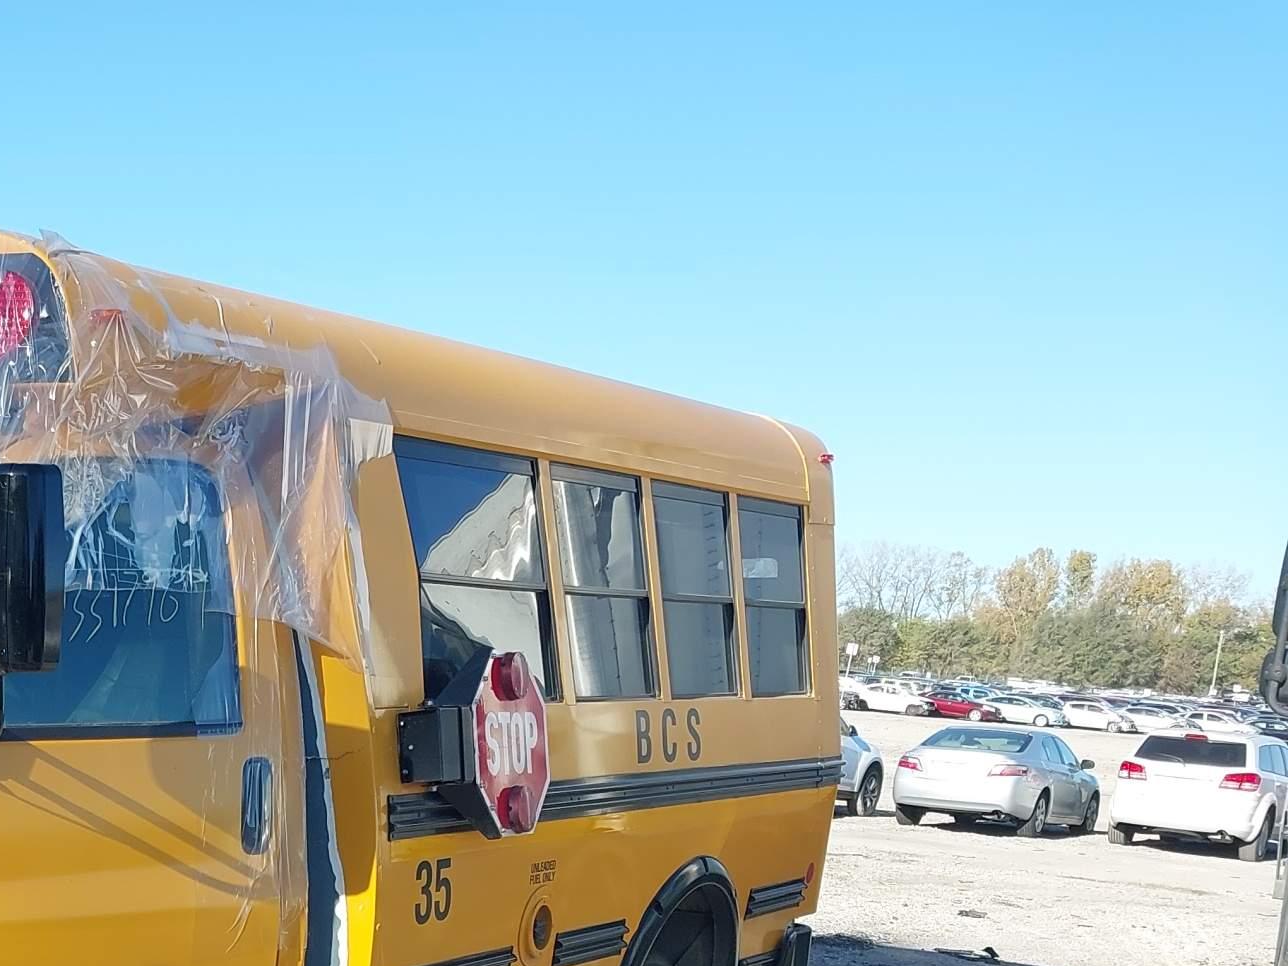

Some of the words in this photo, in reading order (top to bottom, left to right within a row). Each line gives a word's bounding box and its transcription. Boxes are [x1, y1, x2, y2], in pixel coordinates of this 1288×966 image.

[484, 711, 539, 777] STOP
[635, 708, 701, 764] BCS
[414, 857, 452, 925] 35
